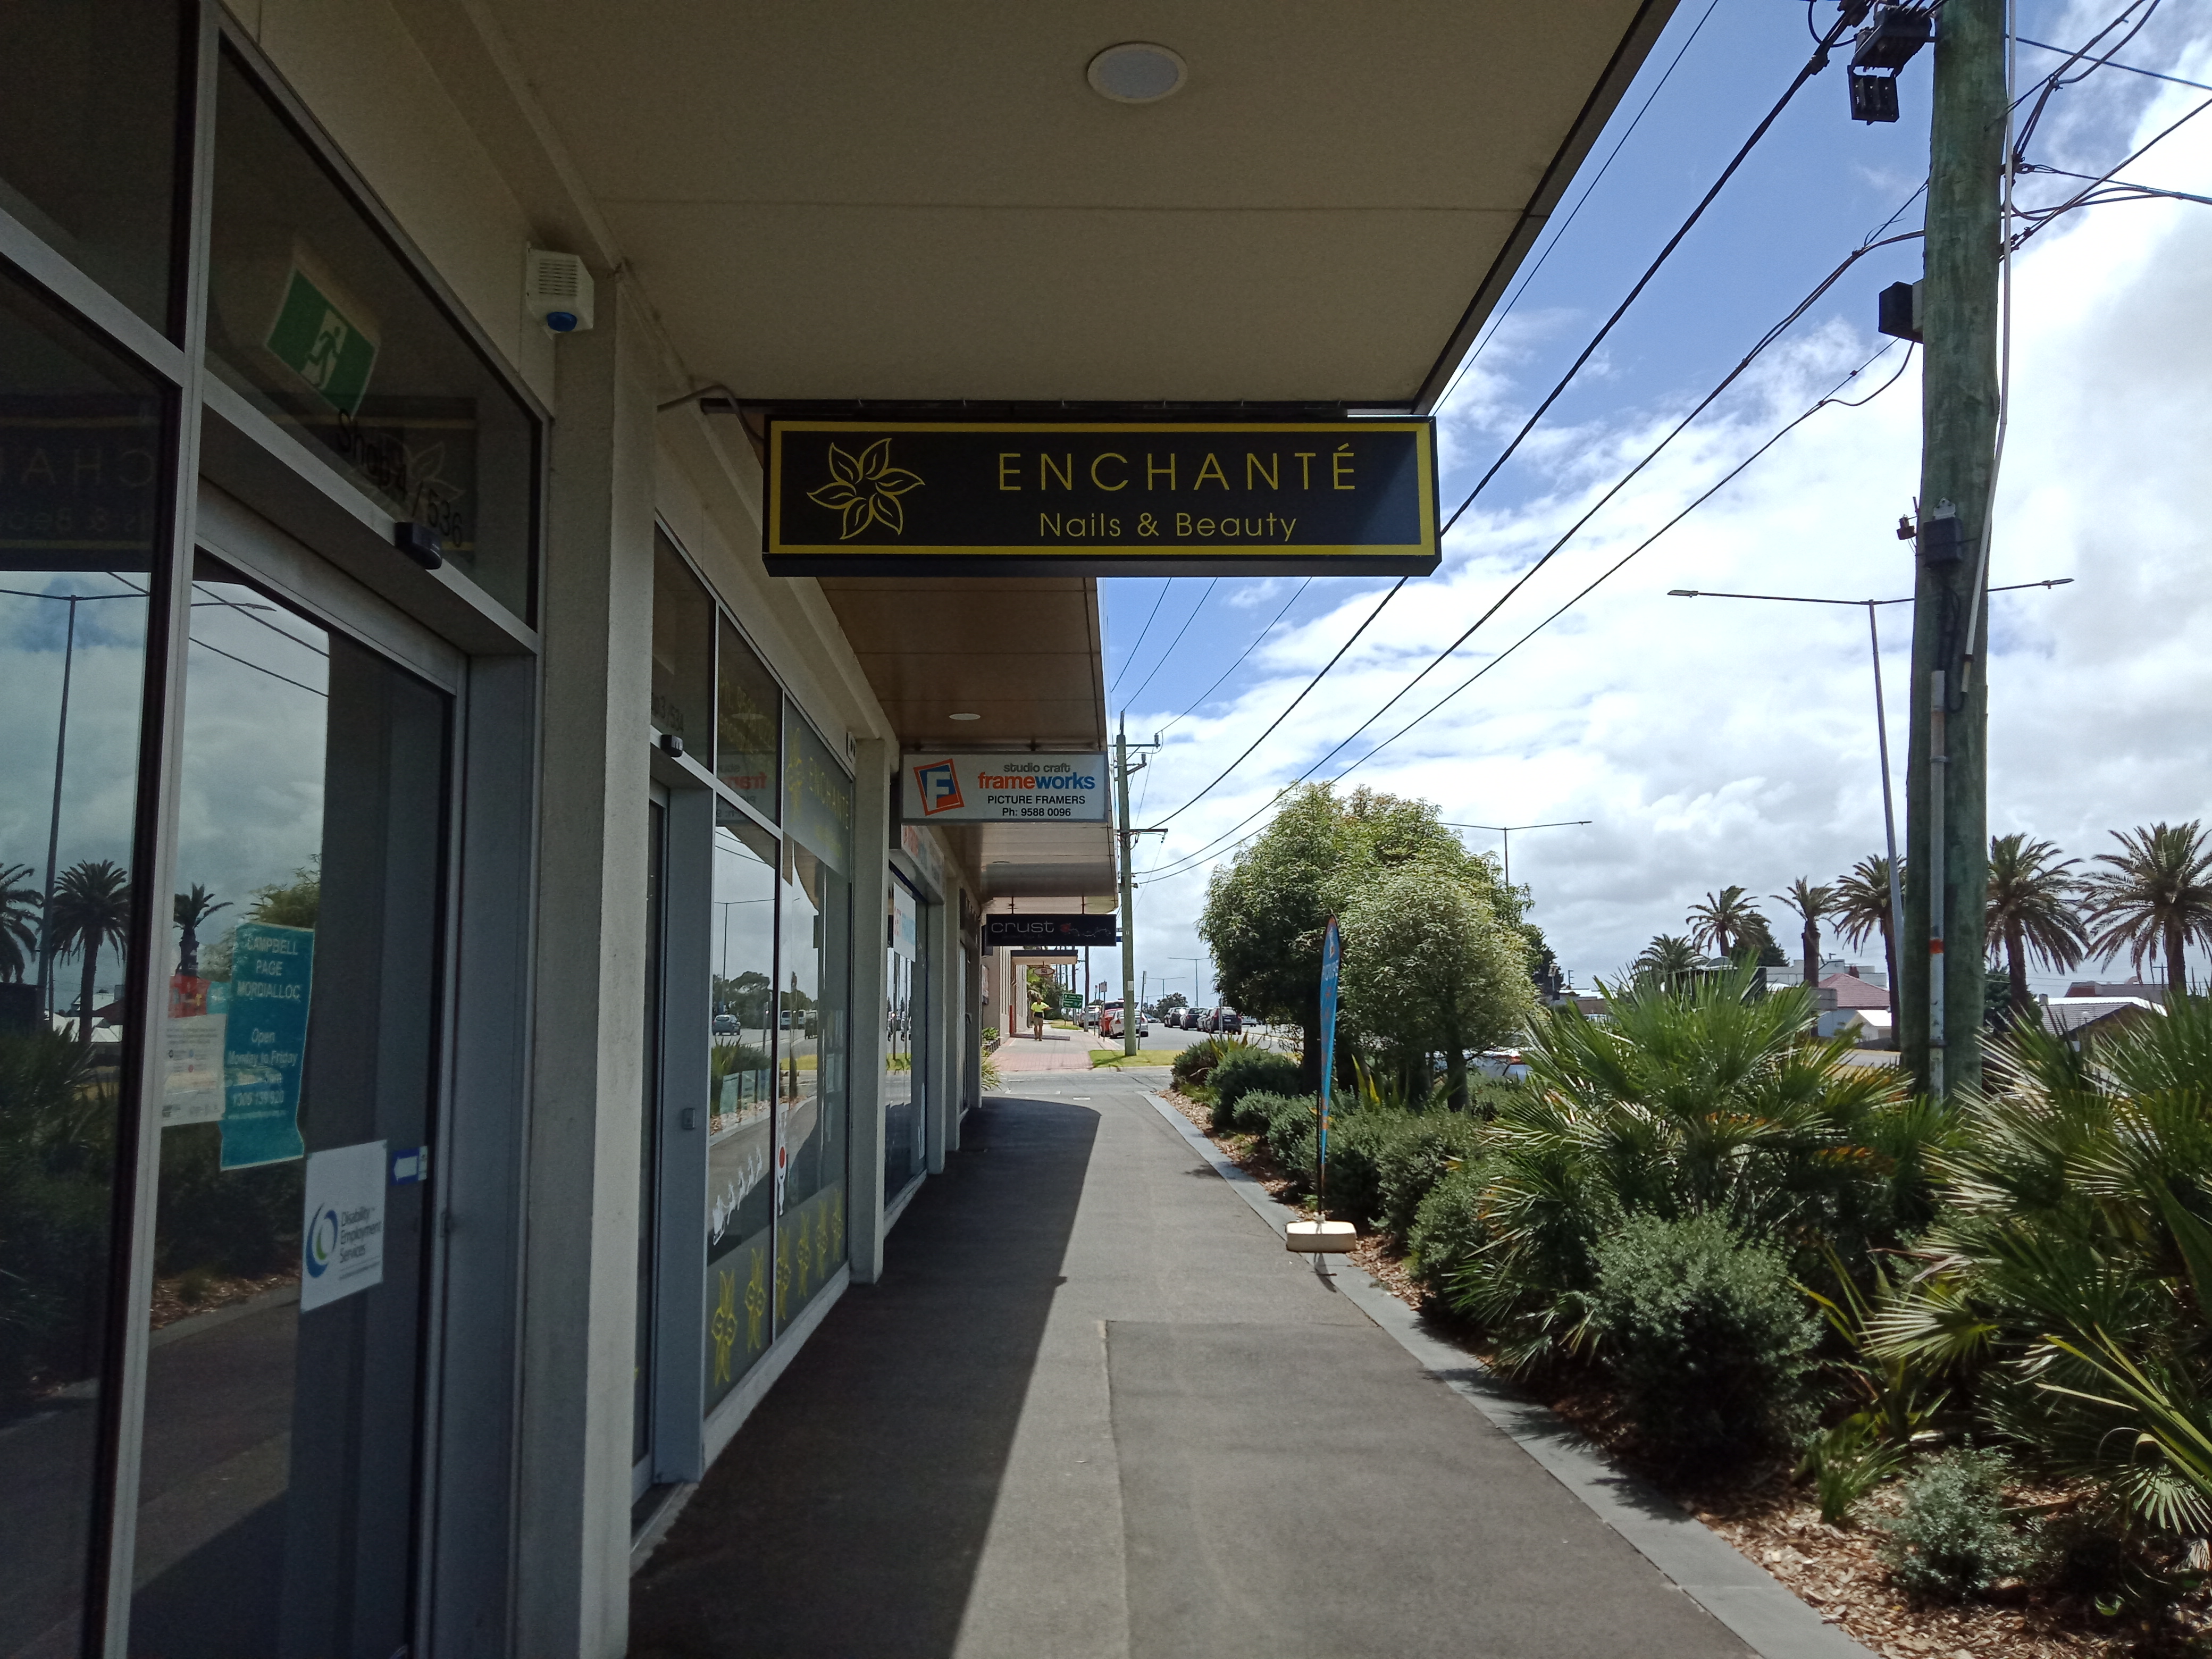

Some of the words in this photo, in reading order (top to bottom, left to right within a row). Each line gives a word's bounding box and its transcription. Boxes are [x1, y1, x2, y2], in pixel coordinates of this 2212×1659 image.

[999, 442, 1356, 491] ENCHANTÉ
[1040, 512, 1121, 538] Nails
[1137, 512, 1160, 537] &
[1176, 512, 1297, 542] Beauty
[1003, 763, 1041, 773] studio
[1043, 763, 1071, 773] craft
[977, 772, 1095, 790] frameworks
[987, 795, 1033, 805] PICTURE
[1035, 795, 1086, 805] FRAMERS
[1002, 808, 1018, 817] Ph:
[1020, 808, 1045, 817] 9588
[1047, 808, 1071, 817] 0096
[991, 920, 1054, 934] crust
[247, 936, 298, 956] CAMPBELL
[256, 959, 283, 976] PAGE
[237, 981, 301, 1000] MORDIALLOC
[252, 1027, 275, 1046] Open
[228, 1050, 258, 1067] Monday
[261, 1051, 269, 1063] to
[271, 1050, 298, 1067] Friday
[341, 1205, 371, 1227] Disability
[340, 1221, 382, 1245] Employment
[340, 1245, 366, 1264] Services
